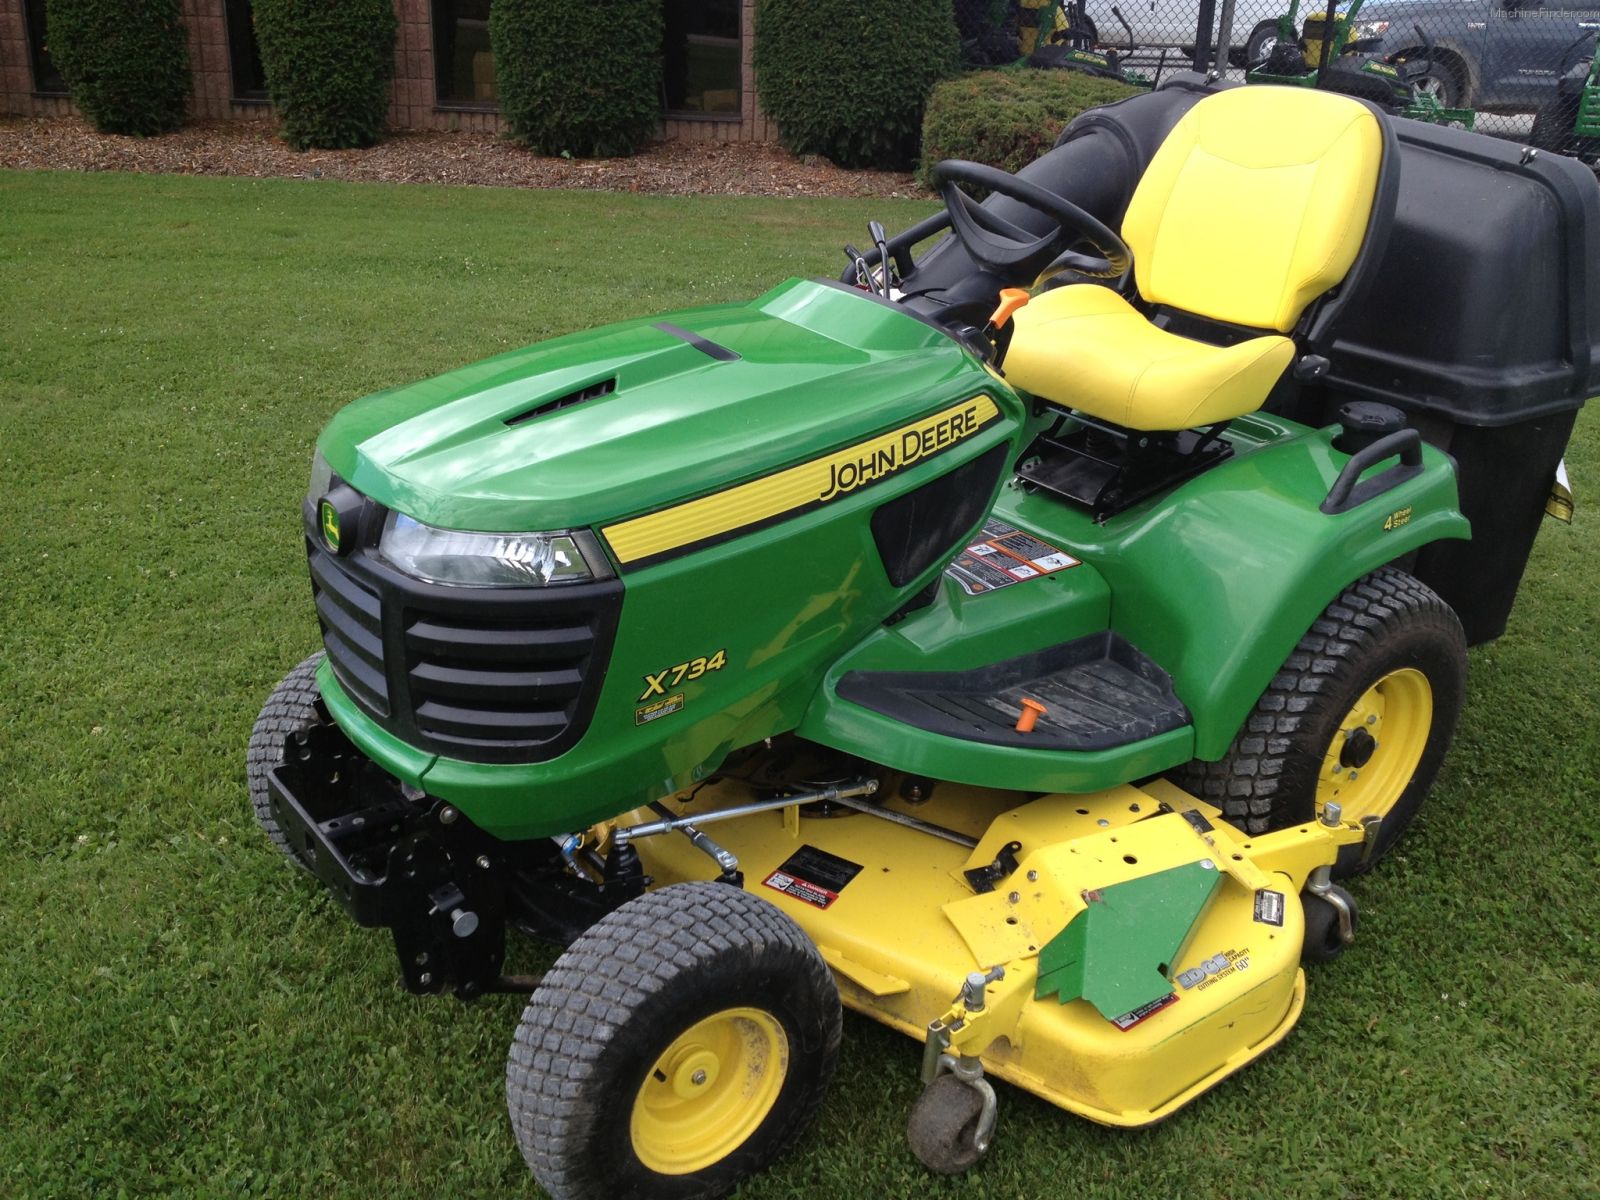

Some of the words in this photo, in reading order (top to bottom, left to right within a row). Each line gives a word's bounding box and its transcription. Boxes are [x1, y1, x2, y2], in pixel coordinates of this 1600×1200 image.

[820, 444, 896, 499] JOHN
[902, 405, 978, 463] DEERE
[639, 648, 727, 701] X734
[1176, 951, 1232, 990] EDGE
[1197, 976, 1218, 991] CUTTING
[1216, 966, 1235, 982] SYSTEM
